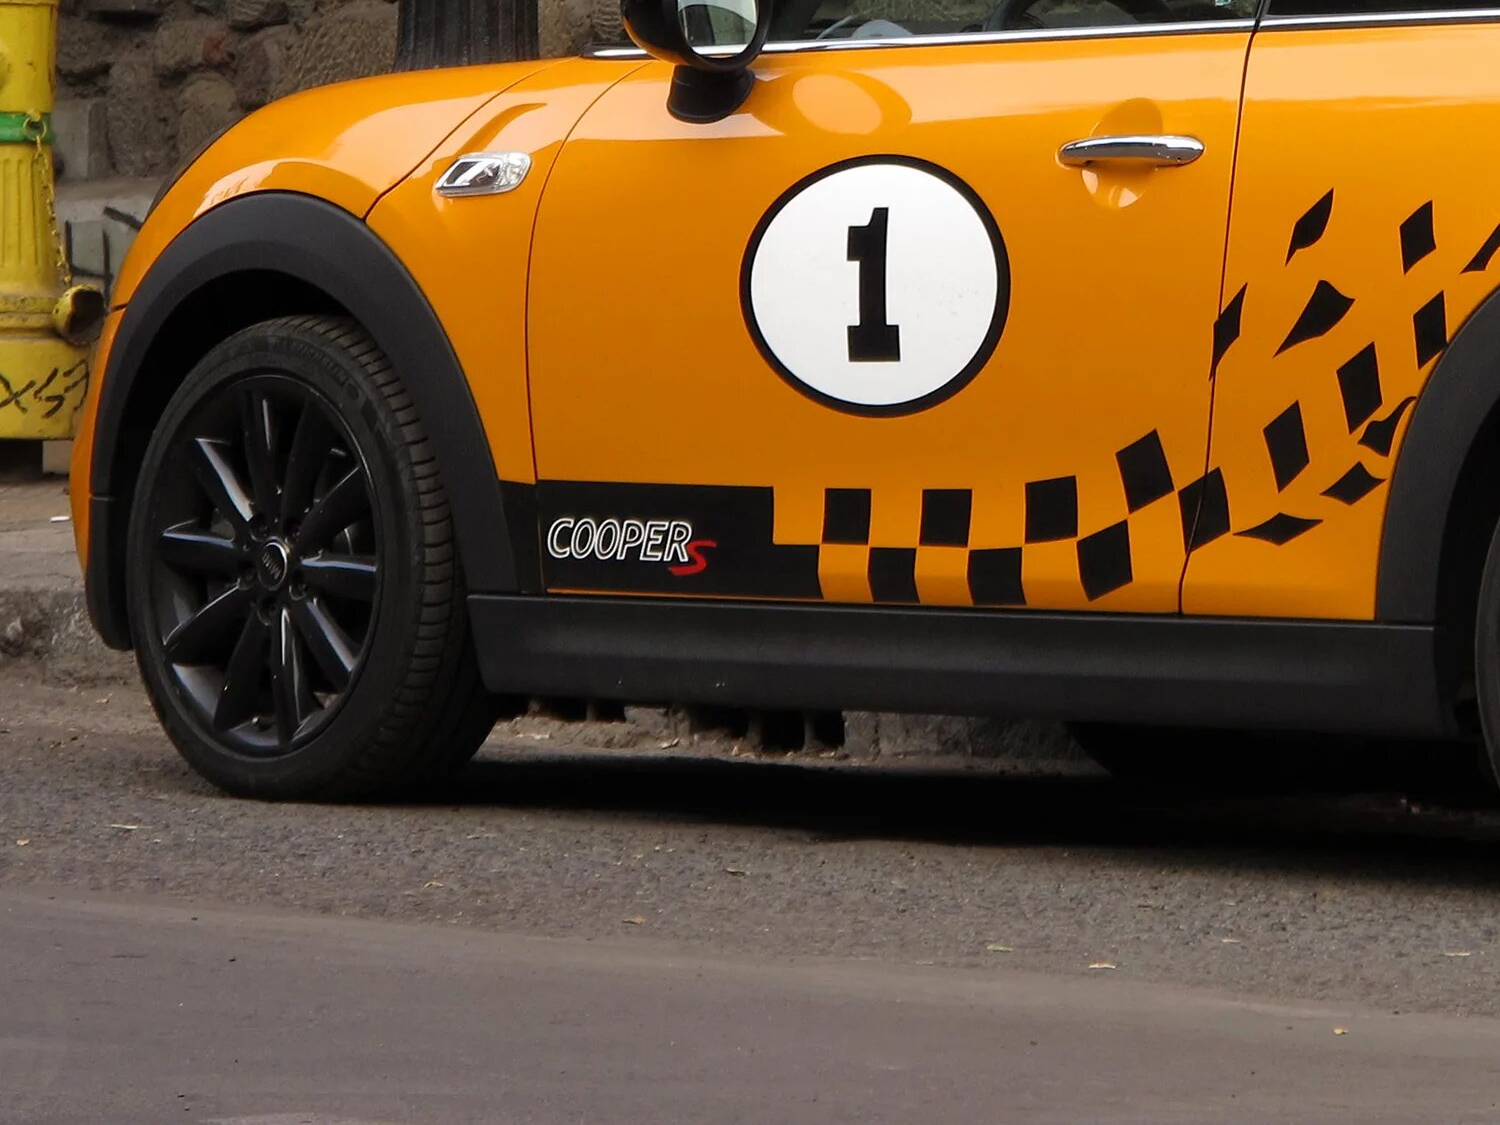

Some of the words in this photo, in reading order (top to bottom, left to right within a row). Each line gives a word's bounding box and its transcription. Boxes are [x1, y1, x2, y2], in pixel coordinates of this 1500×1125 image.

[846, 207, 901, 363] 1
[547, 518, 692, 562] COOPER
[667, 540, 717, 576] S
